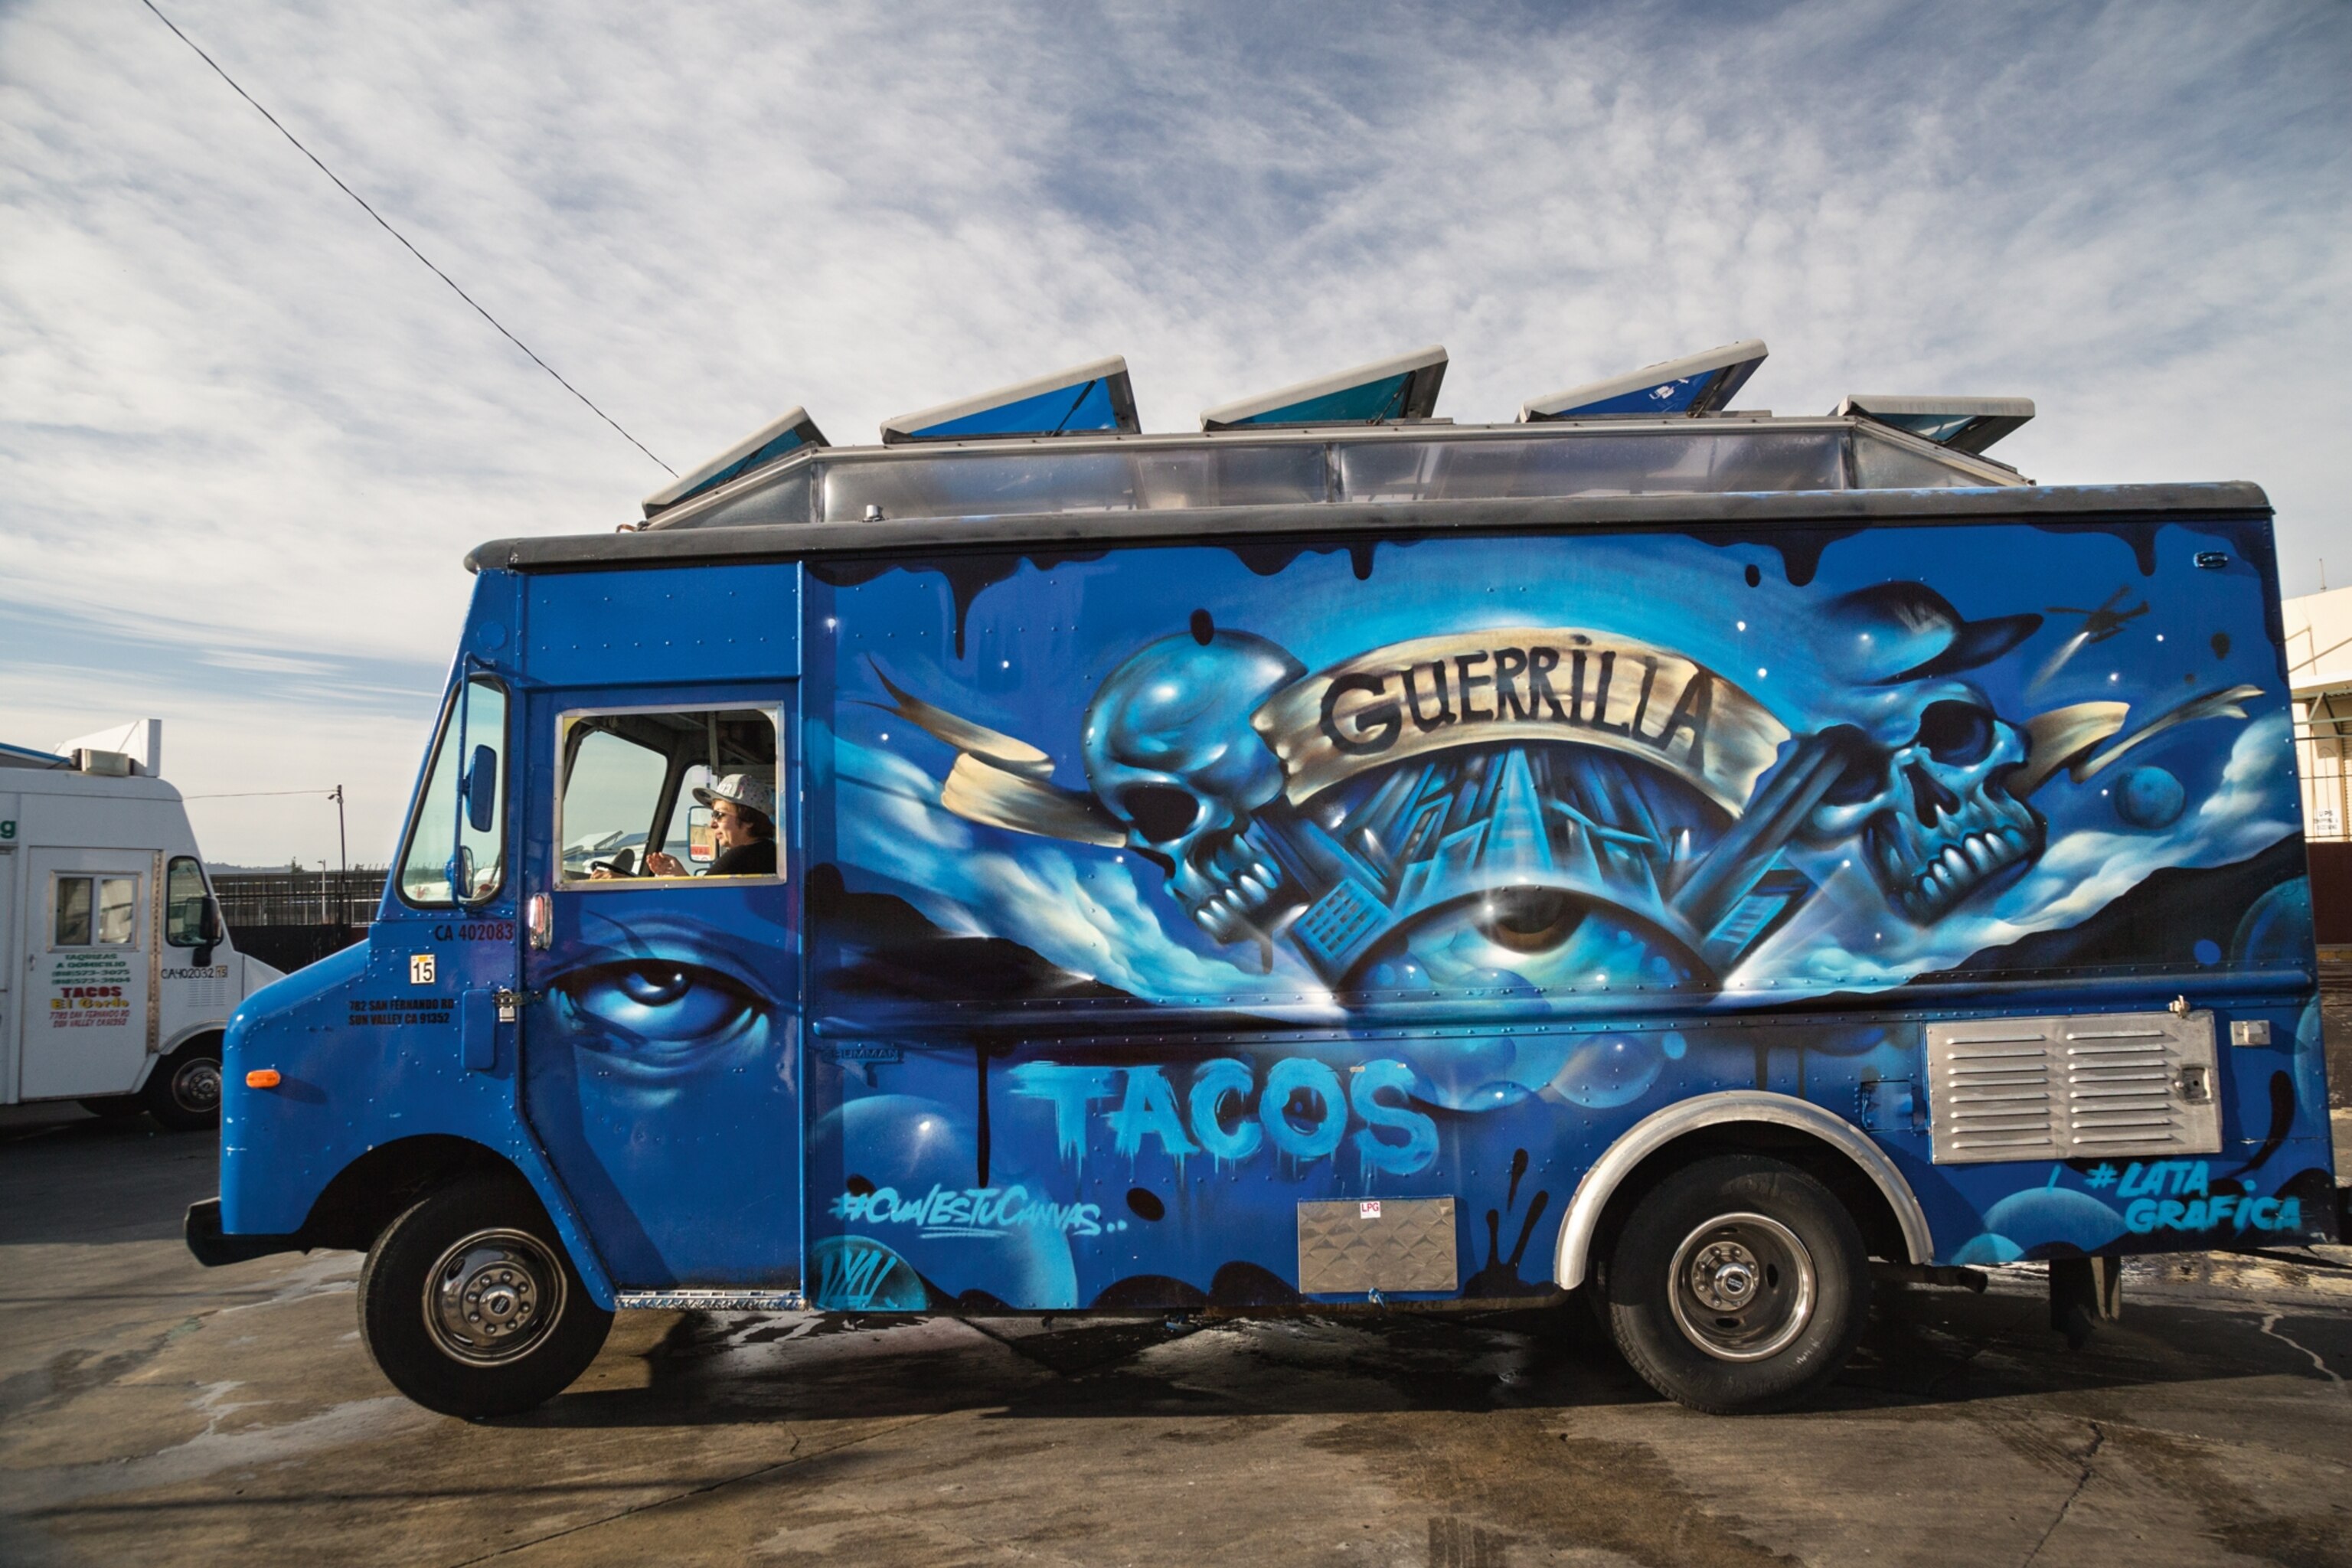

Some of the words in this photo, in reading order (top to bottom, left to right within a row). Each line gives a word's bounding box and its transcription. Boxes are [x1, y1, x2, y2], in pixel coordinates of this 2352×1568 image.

[1319, 634, 1713, 764] GUERRILLA
[434, 925, 453, 941] CA
[459, 923, 514, 940] 402083
[413, 962, 433, 982] 15
[60, 986, 122, 998] TACOS
[51, 998, 73, 1009] El
[369, 999, 387, 1011] SAN
[390, 998, 439, 1010] FERNANDO
[441, 998, 454, 1009] RD
[349, 1014, 368, 1025] SUN
[371, 1014, 403, 1024] VALLEY
[404, 1013, 417, 1024] CA
[420, 1012, 449, 1024] 91352
[1008, 1057, 1440, 1178] TACOS
[1362, 1202, 1379, 1212] LPG
[2125, 1180, 2301, 1234] GRAFICA
